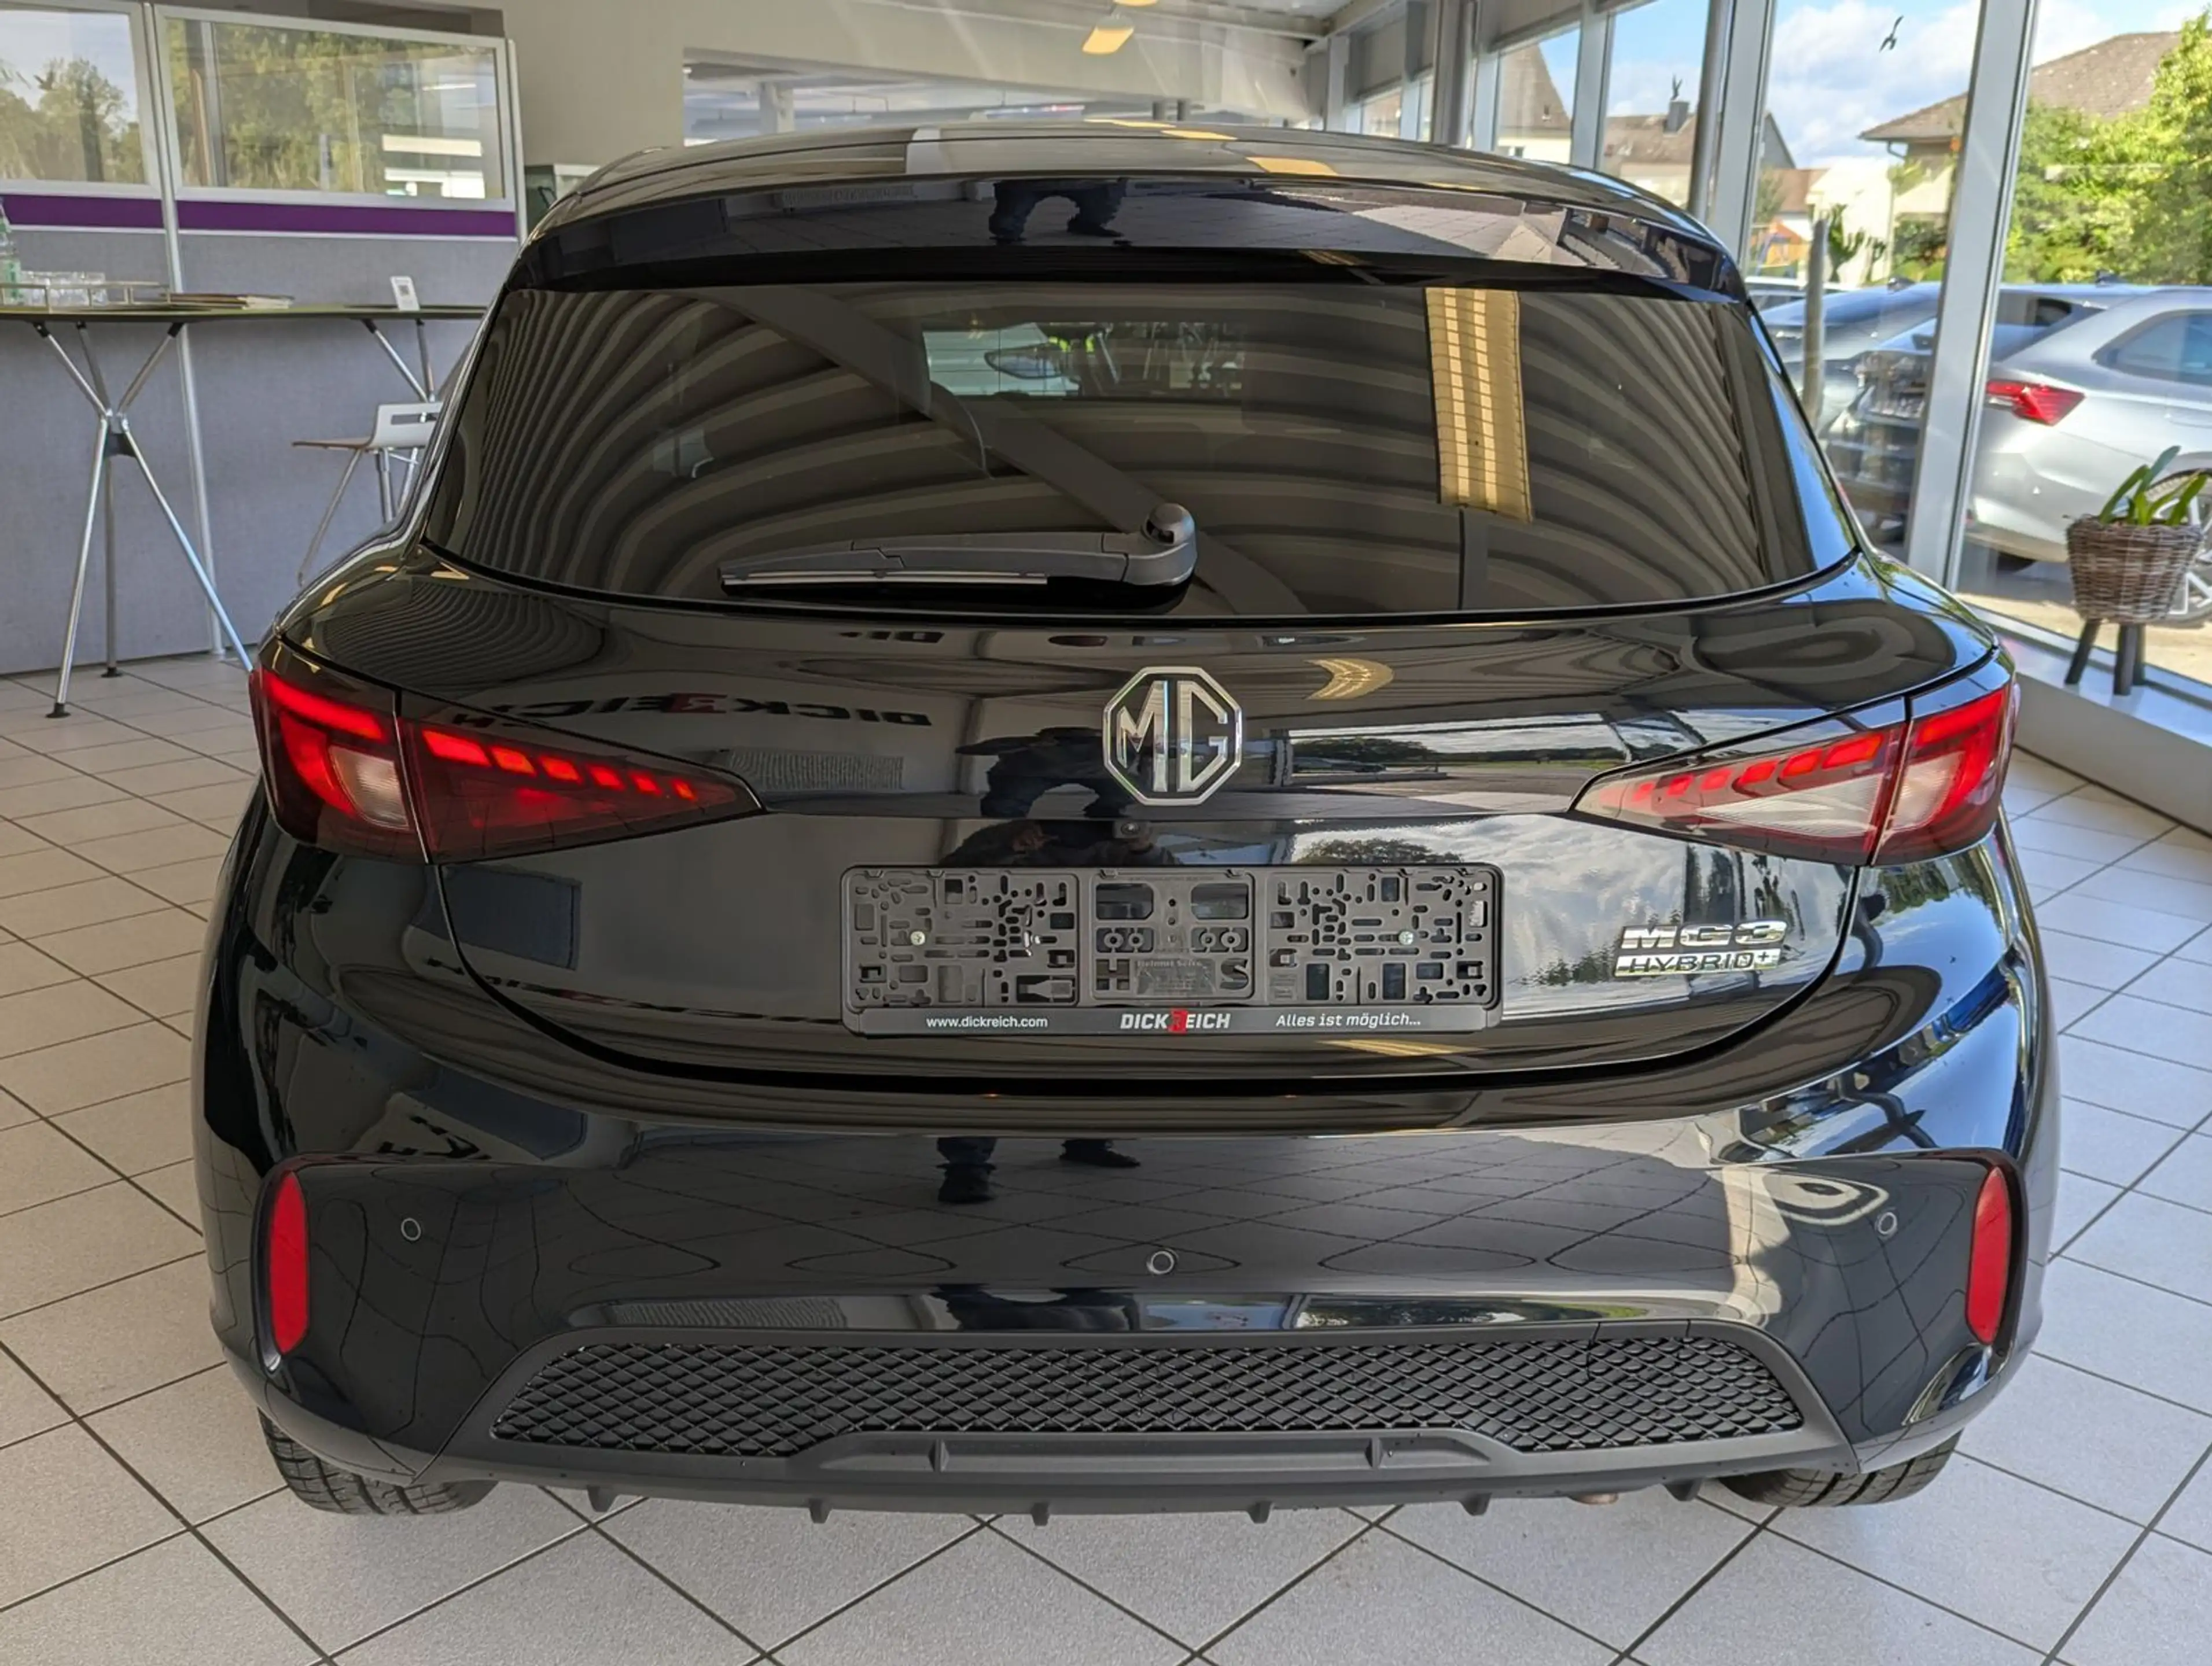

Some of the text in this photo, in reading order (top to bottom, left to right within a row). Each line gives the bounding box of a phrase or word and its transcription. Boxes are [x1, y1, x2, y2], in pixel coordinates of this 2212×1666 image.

[1117, 680, 1228, 793] MG
[1621, 920, 1787, 949] MG3
[1628, 950, 1771, 973] HYBRID+
[926, 1016, 1048, 1028] www.dickreich.com
[1275, 1013, 1315, 1027] Alles
[1318, 1013, 1344, 1027] ist
